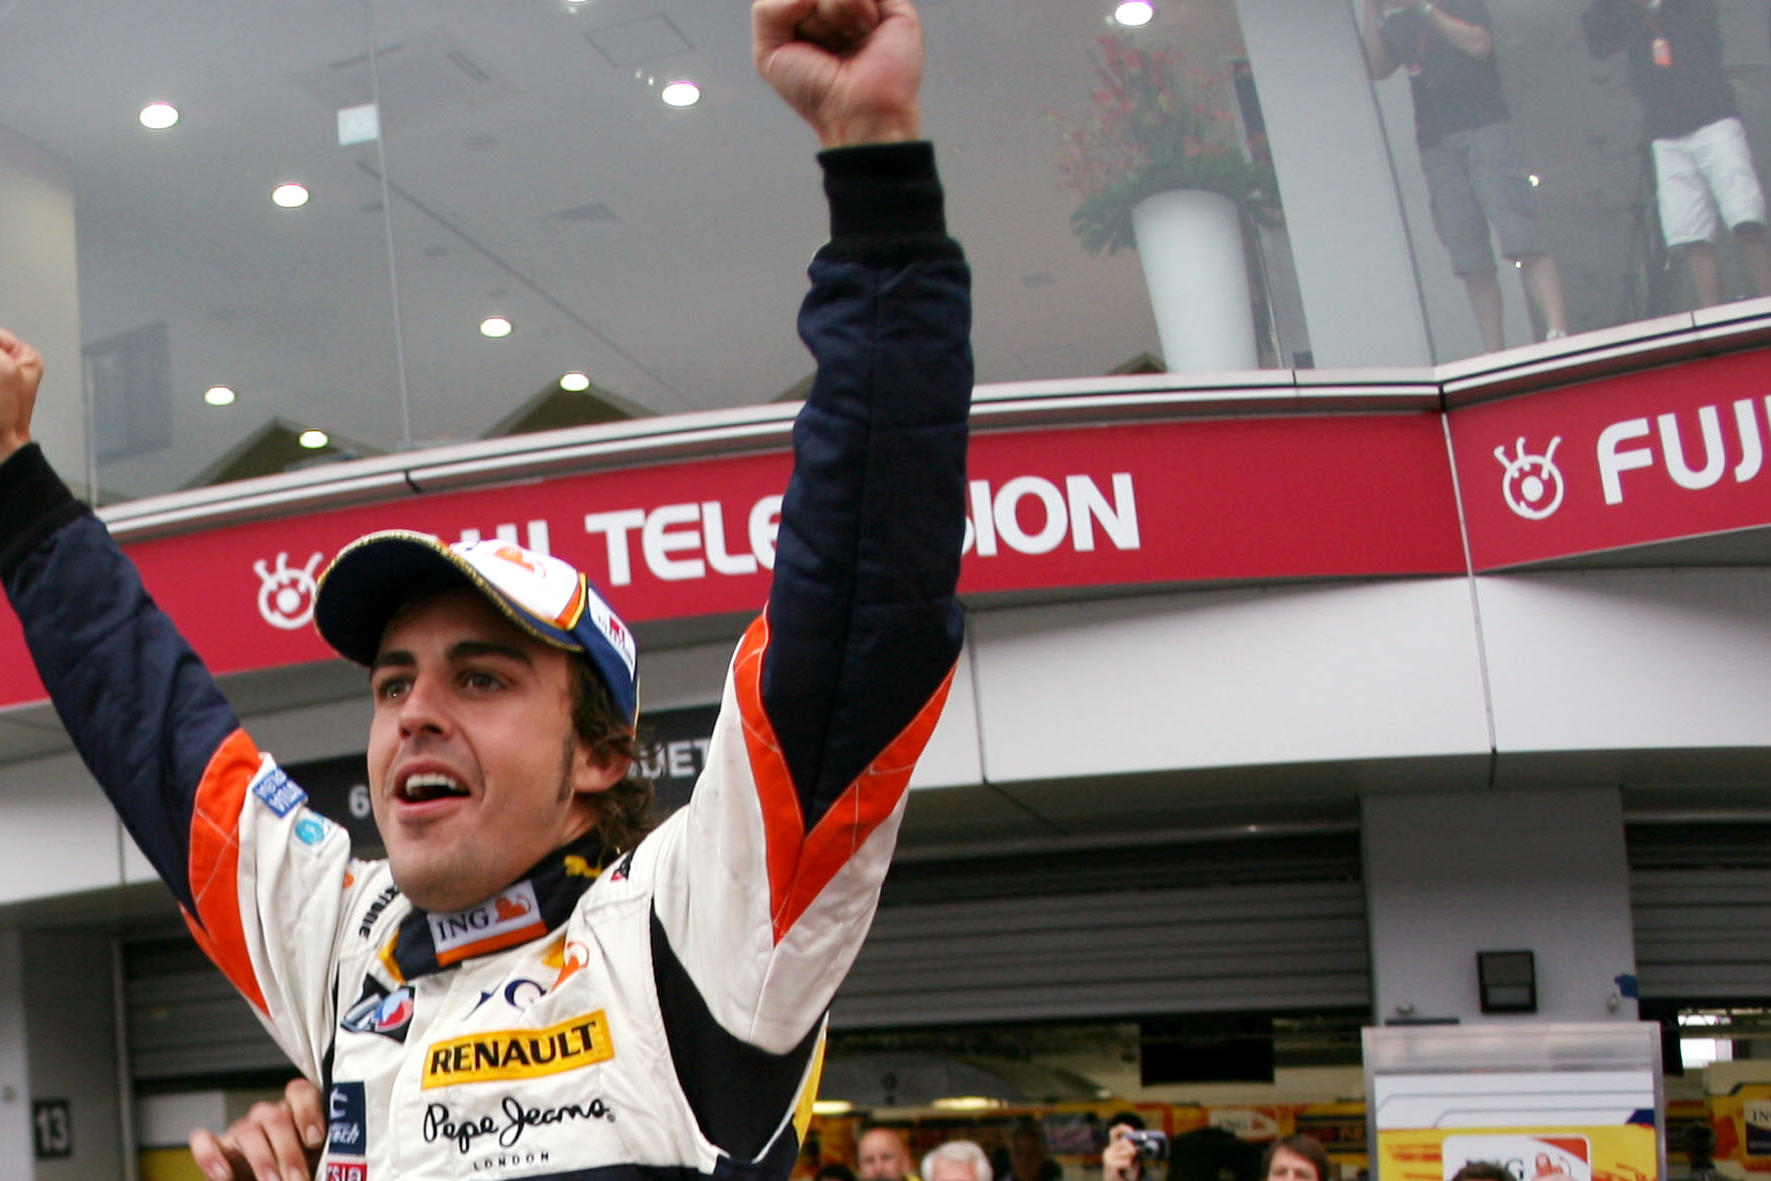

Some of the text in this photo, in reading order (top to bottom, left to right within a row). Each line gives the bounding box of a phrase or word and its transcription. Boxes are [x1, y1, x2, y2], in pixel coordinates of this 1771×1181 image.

[436, 907, 491, 942] ING
[429, 1021, 597, 1075] RENAULT
[36, 1107, 69, 1152] 13
[422, 1096, 612, 1155] Pepe Jeans
[472, 1151, 551, 1173] LONDON
